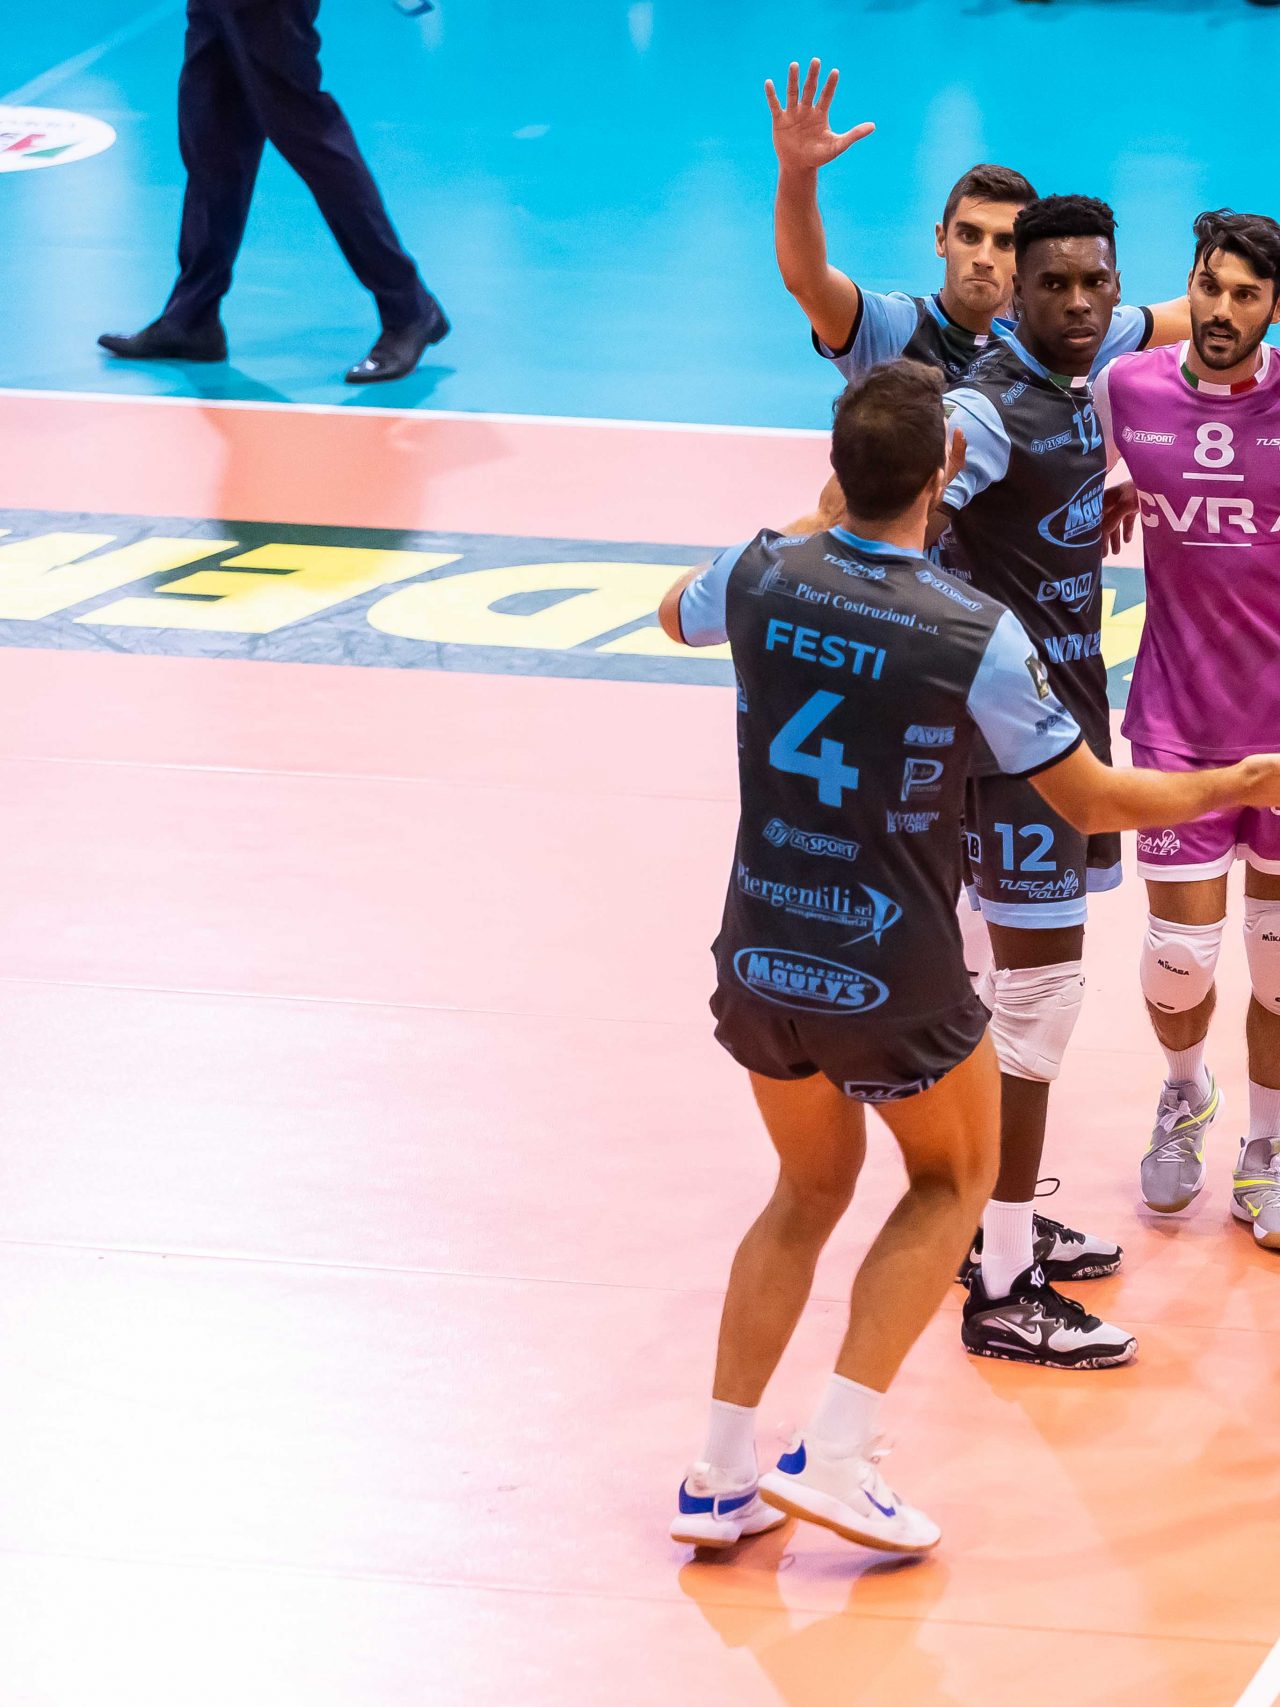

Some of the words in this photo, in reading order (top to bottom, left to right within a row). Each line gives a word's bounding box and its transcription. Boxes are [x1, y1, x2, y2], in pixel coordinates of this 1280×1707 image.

[1073, 403, 1103, 456] 12
[1145, 434, 1174, 443] SPORT
[1193, 421, 1235, 469] 8
[1137, 490, 1258, 534] CVR
[795, 583, 831, 605] Pieri
[832, 595, 917, 628] Costruzioni
[1037, 572, 1092, 602] COM
[765, 618, 887, 681] FESTI
[769, 689, 860, 808] 4
[808, 836, 856, 858] SPORT
[994, 822, 1057, 872] 12
[737, 861, 850, 915] Piergentili
[854, 904, 873, 917] srl
[1000, 875, 1079, 890] TUSCANIA
[1028, 886, 1079, 899] VOLLEY
[747, 953, 866, 1007] Maury's
[773, 959, 861, 982] MAGAZZINI
